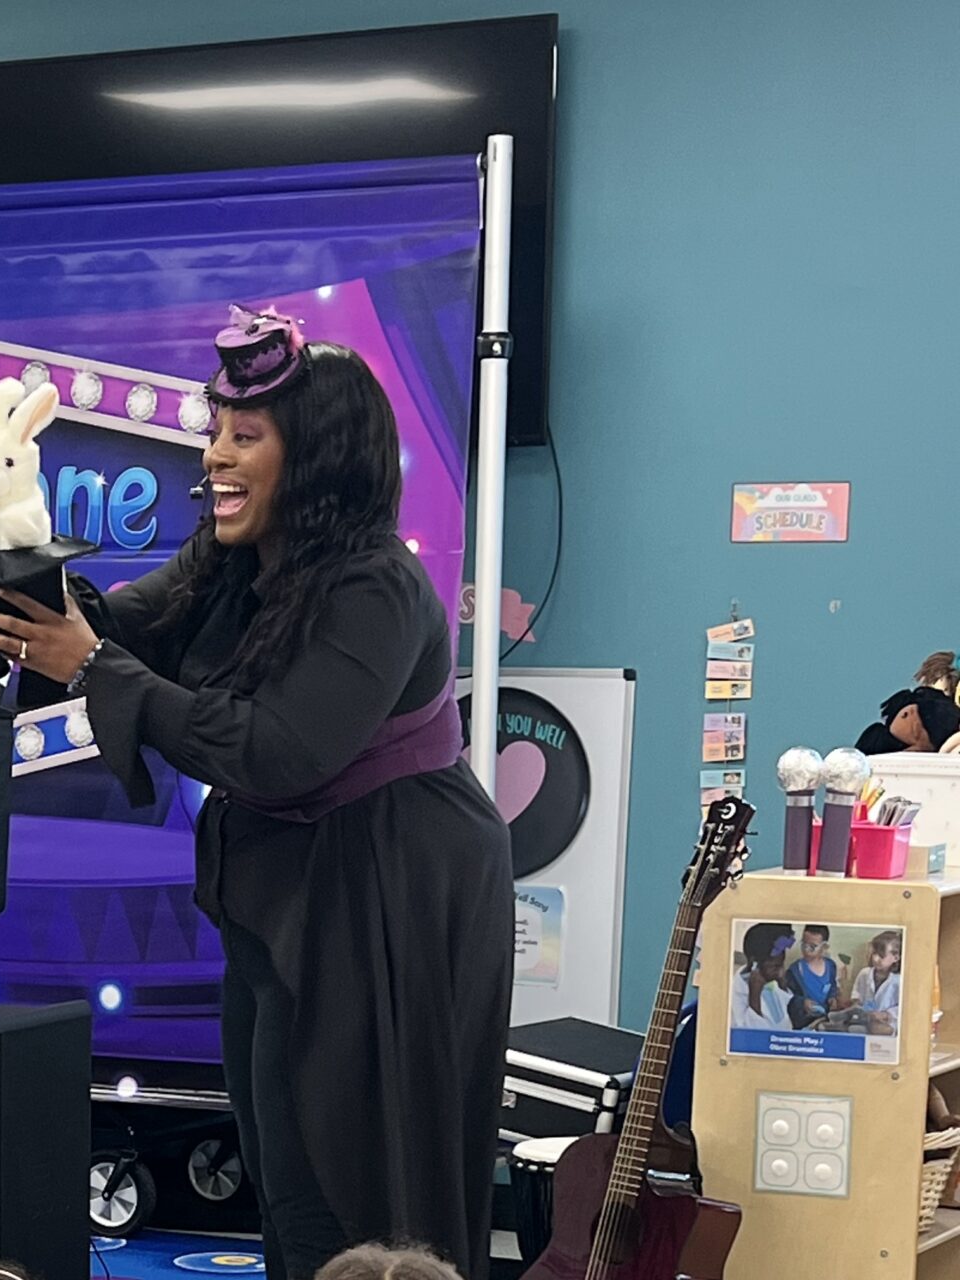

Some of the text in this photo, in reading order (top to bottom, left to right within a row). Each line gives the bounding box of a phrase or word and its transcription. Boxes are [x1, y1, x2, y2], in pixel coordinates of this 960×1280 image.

[755, 511, 826, 531] SCHEDULE
[505, 713, 532, 735] YOU
[535, 720, 567, 750] WELL
